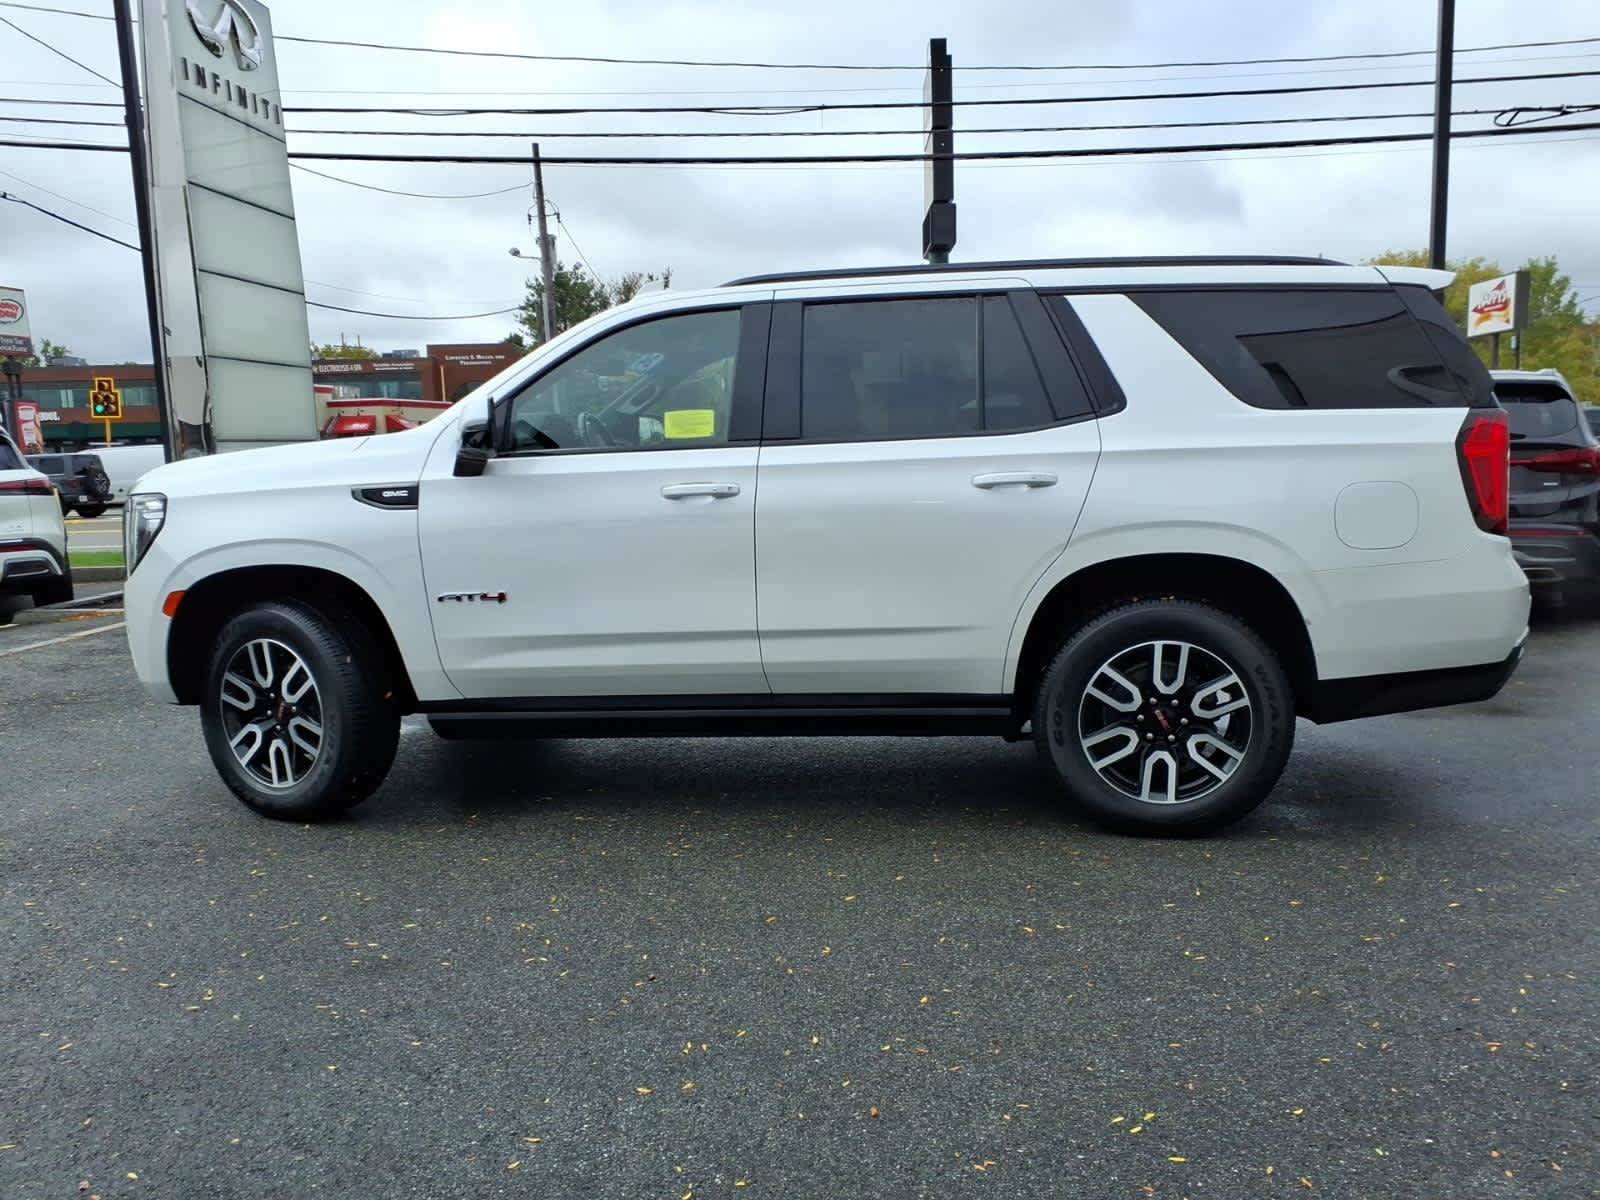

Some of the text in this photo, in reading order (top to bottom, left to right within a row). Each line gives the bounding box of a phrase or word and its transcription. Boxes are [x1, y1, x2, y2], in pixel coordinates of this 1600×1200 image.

[181, 56, 281, 125] INFINITI
[382, 490, 409, 498] GMC
[437, 591, 508, 604] AT4
